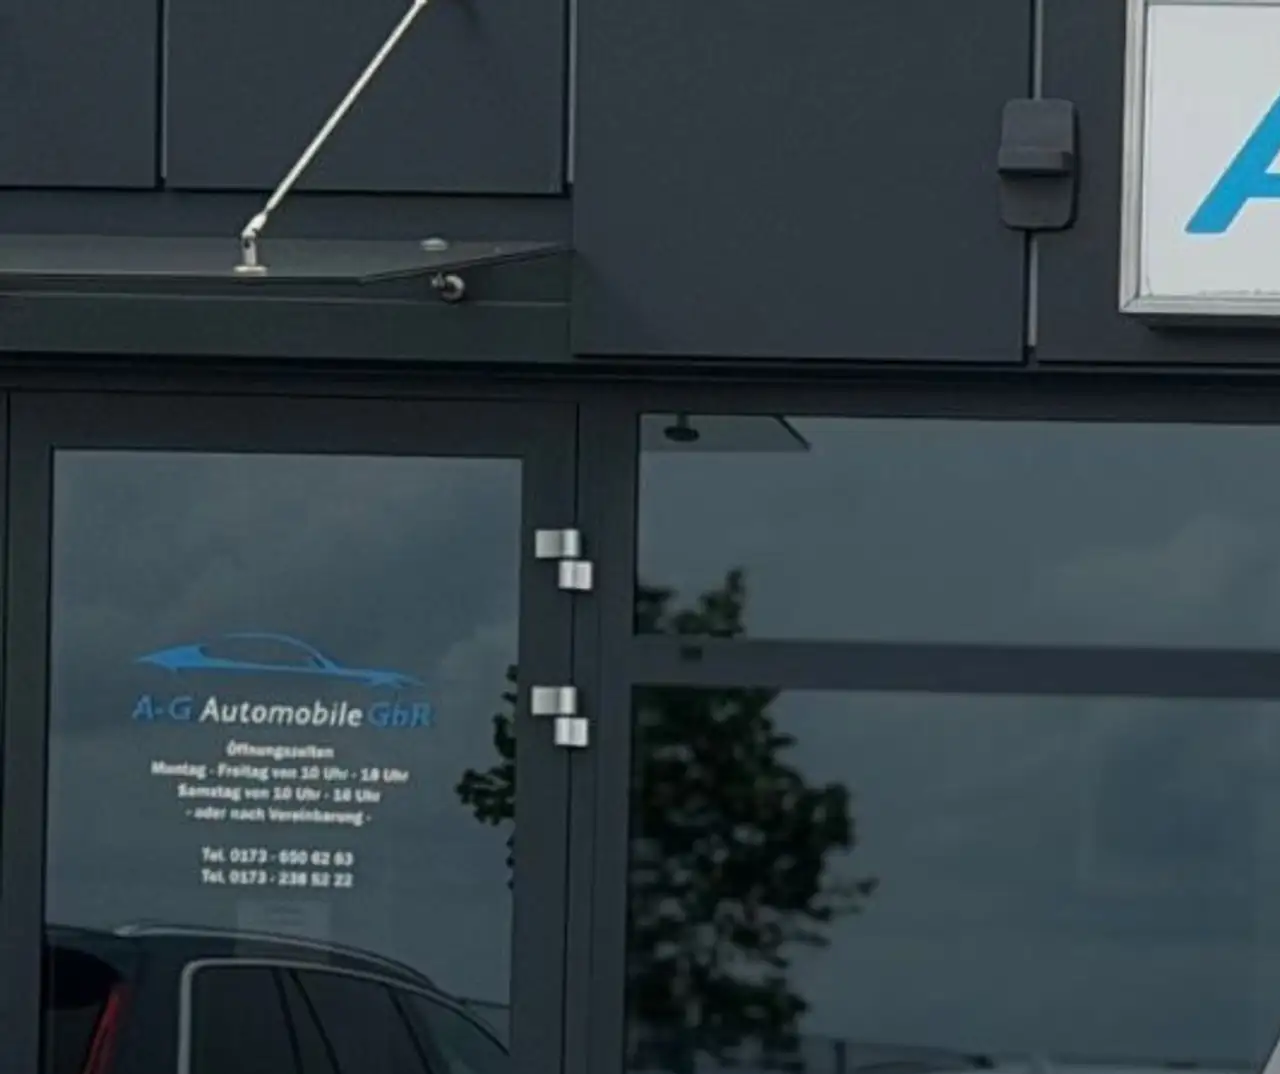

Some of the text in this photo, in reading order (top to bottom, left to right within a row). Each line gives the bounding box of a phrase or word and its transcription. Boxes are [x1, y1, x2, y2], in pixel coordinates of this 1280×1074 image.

[131, 695, 431, 728] A-G Automobile GbR
[226, 740, 335, 761] Öffnungszeiten
[151, 760, 207, 780] Montag
[217, 762, 269, 781] Freitag
[271, 768, 298, 779] von
[300, 765, 321, 780] 10
[322, 766, 350, 781] Uhr
[383, 767, 410, 783] Uhr
[177, 783, 242, 802] Samstag
[244, 789, 271, 800] von
[273, 786, 294, 801] 10
[295, 786, 322, 801] Uhr
[355, 788, 381, 803] Uhr
[194, 805, 227, 820] oder
[230, 806, 265, 821] nach
[268, 806, 365, 827] Vereinbarung
[202, 847, 227, 862] Tel.
[230, 848, 268, 863] 0173
[202, 868, 227, 884] Tel.
[229, 869, 268, 885] 0173
